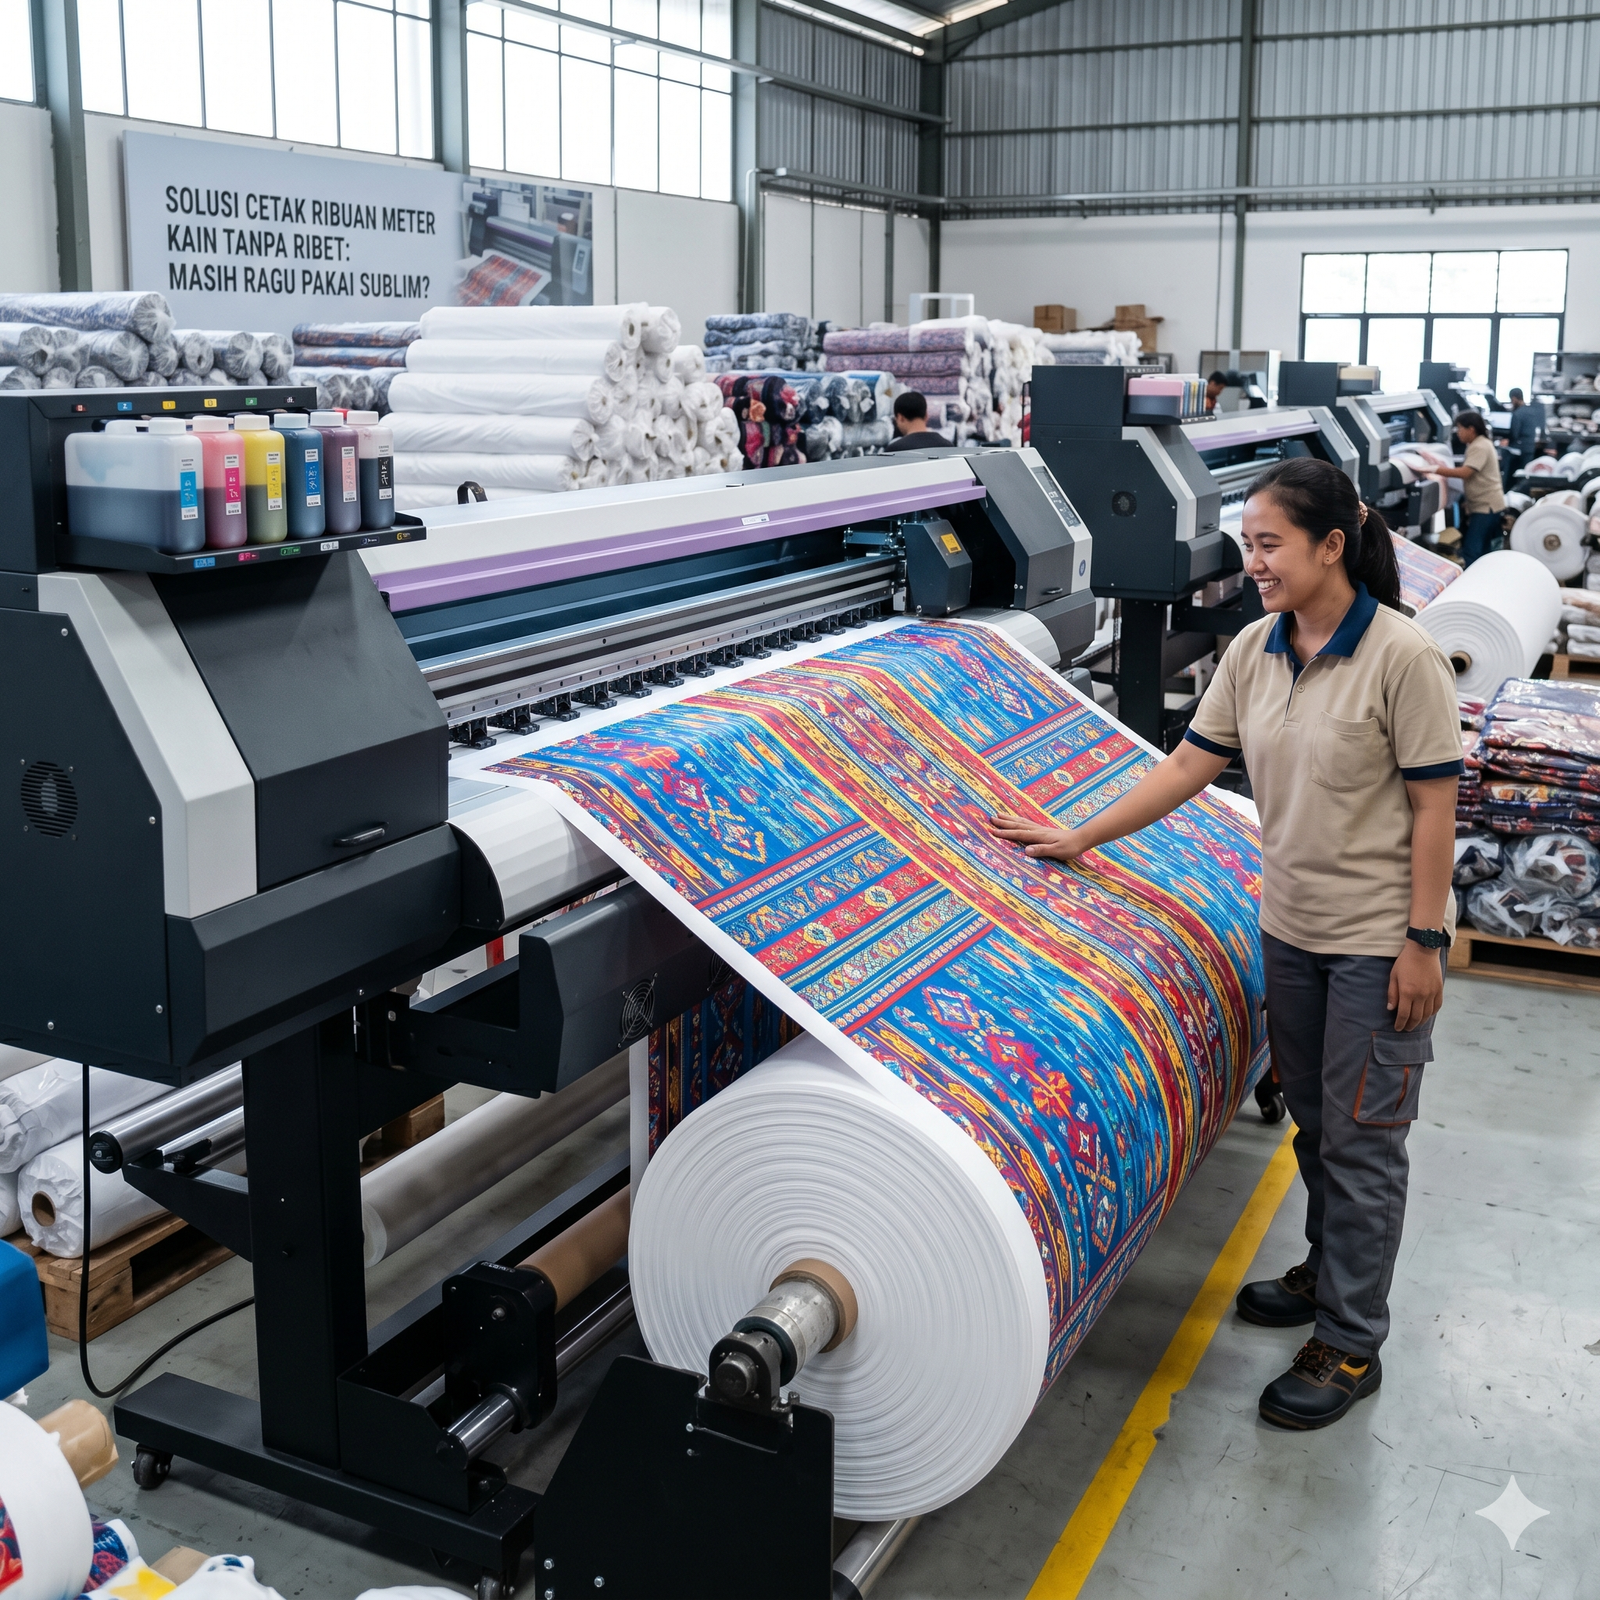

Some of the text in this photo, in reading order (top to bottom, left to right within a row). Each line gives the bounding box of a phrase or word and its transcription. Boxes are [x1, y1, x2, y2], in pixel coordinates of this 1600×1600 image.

[165, 185, 436, 236] SOLUSI CETAK RIBUAN METER
[167, 223, 350, 262] KAIN TANPA RIBET:
[168, 262, 431, 299] MASIH RAGU PAKAI SUBLIM?
